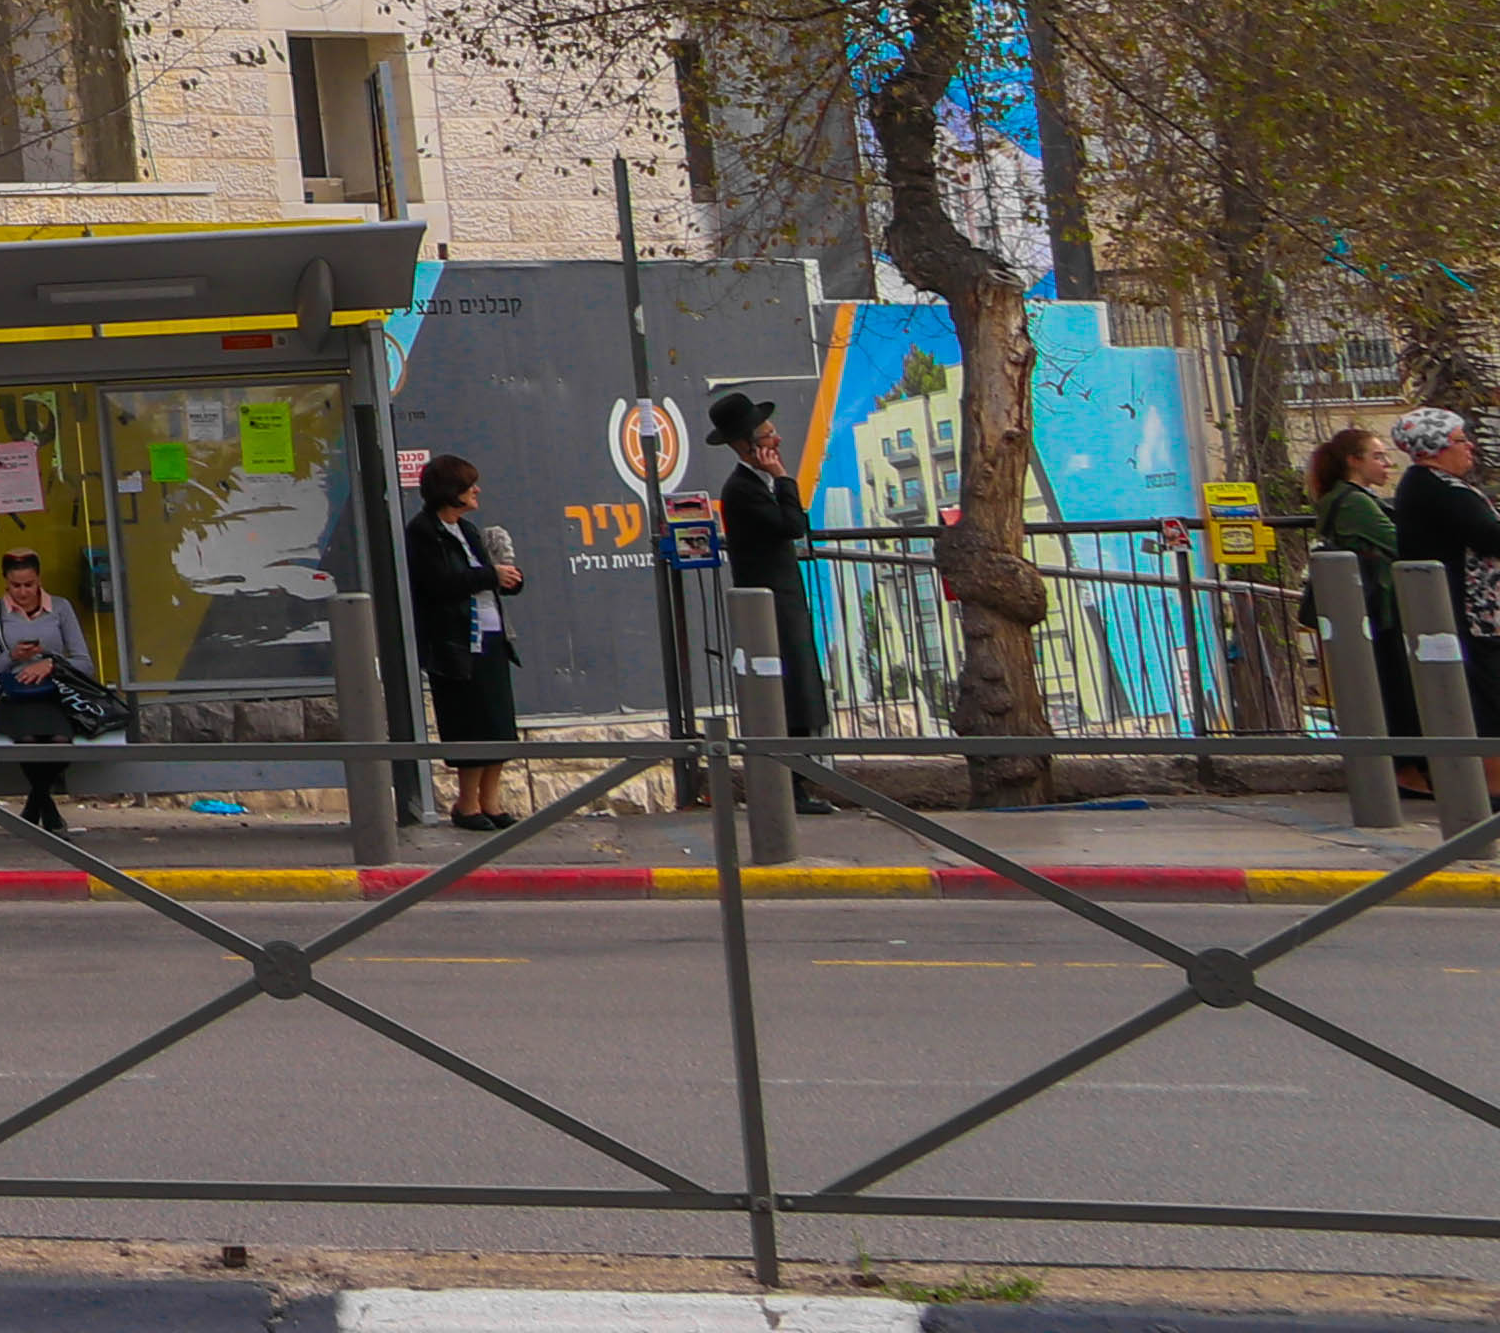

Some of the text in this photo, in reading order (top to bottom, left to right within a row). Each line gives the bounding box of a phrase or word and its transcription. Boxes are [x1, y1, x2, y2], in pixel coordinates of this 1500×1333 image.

[460, 294, 522, 318] קבלנים
[564, 503, 642, 549] עיר
[611, 552, 655, 568] מנויות
